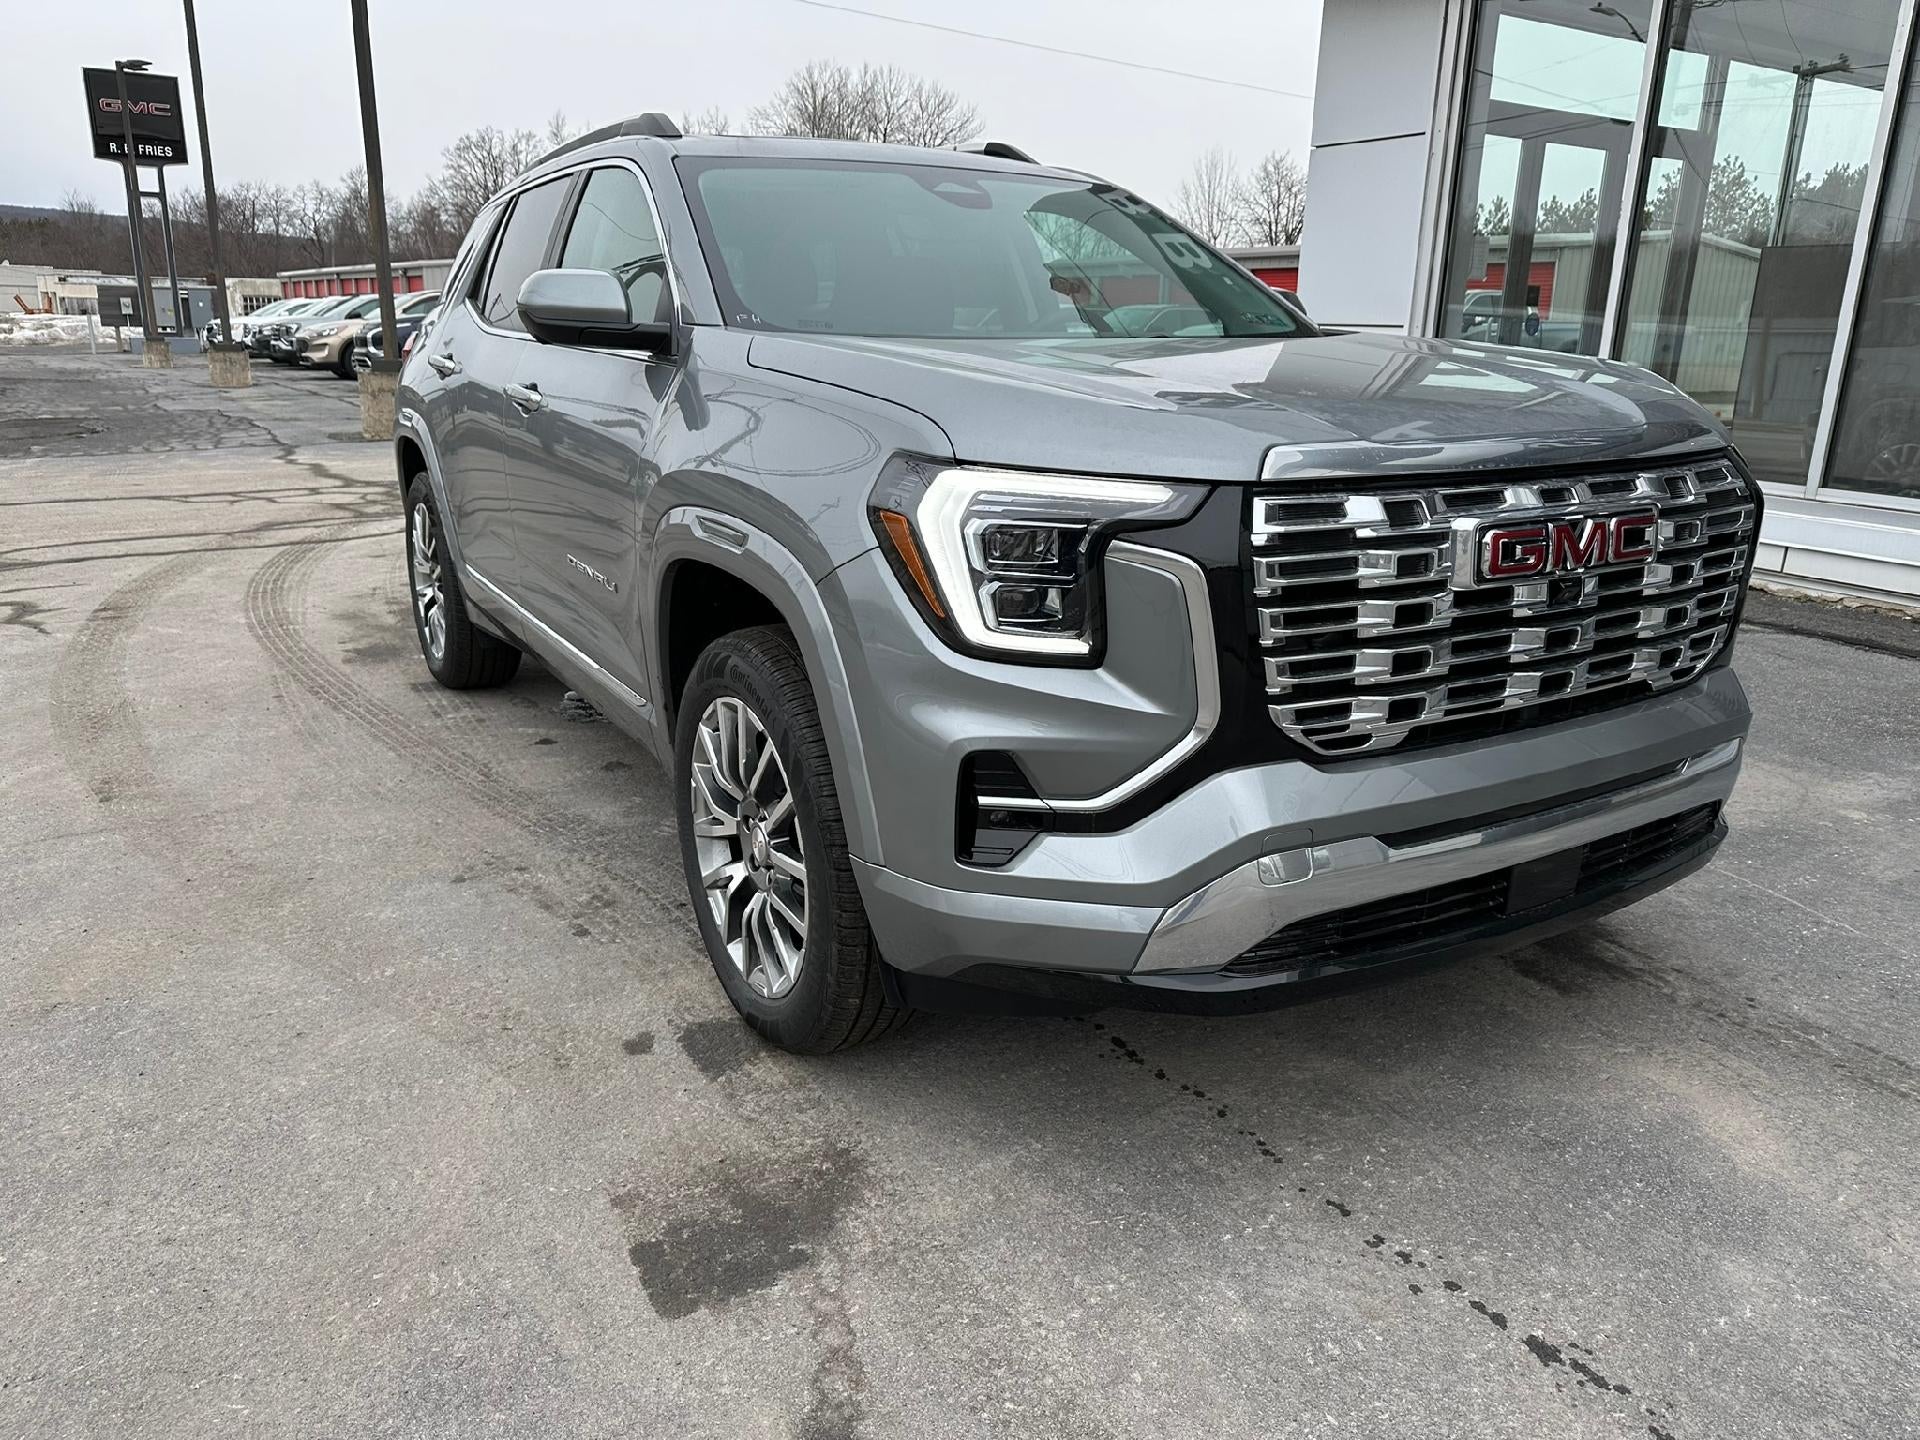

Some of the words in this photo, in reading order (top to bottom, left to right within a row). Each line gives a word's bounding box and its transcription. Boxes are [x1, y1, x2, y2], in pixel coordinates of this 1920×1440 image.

[98, 98, 172, 117] GMC
[138, 144, 173, 157] FRIES
[1482, 514, 1657, 578] GMC
[566, 553, 619, 594] DENALI
